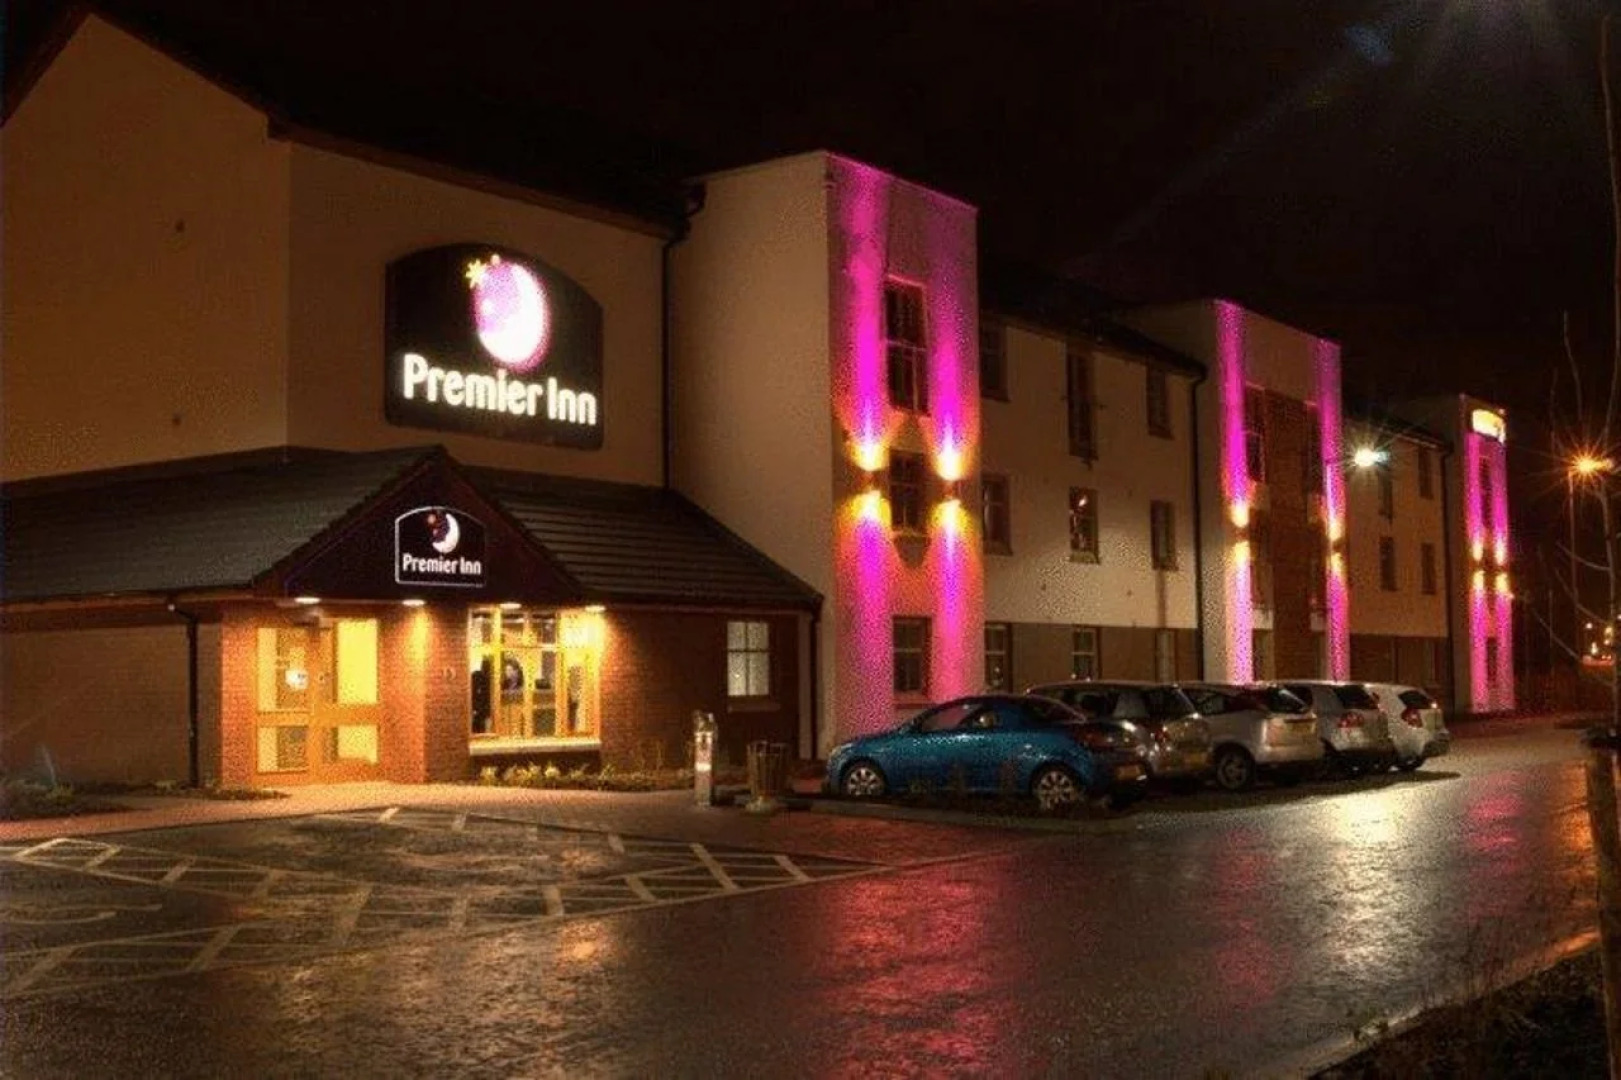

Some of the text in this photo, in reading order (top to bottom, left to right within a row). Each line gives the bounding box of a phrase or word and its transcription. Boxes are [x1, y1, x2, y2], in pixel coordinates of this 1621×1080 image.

[403, 353, 597, 425] Premier Inn
[402, 552, 482, 575] Premier Inn
